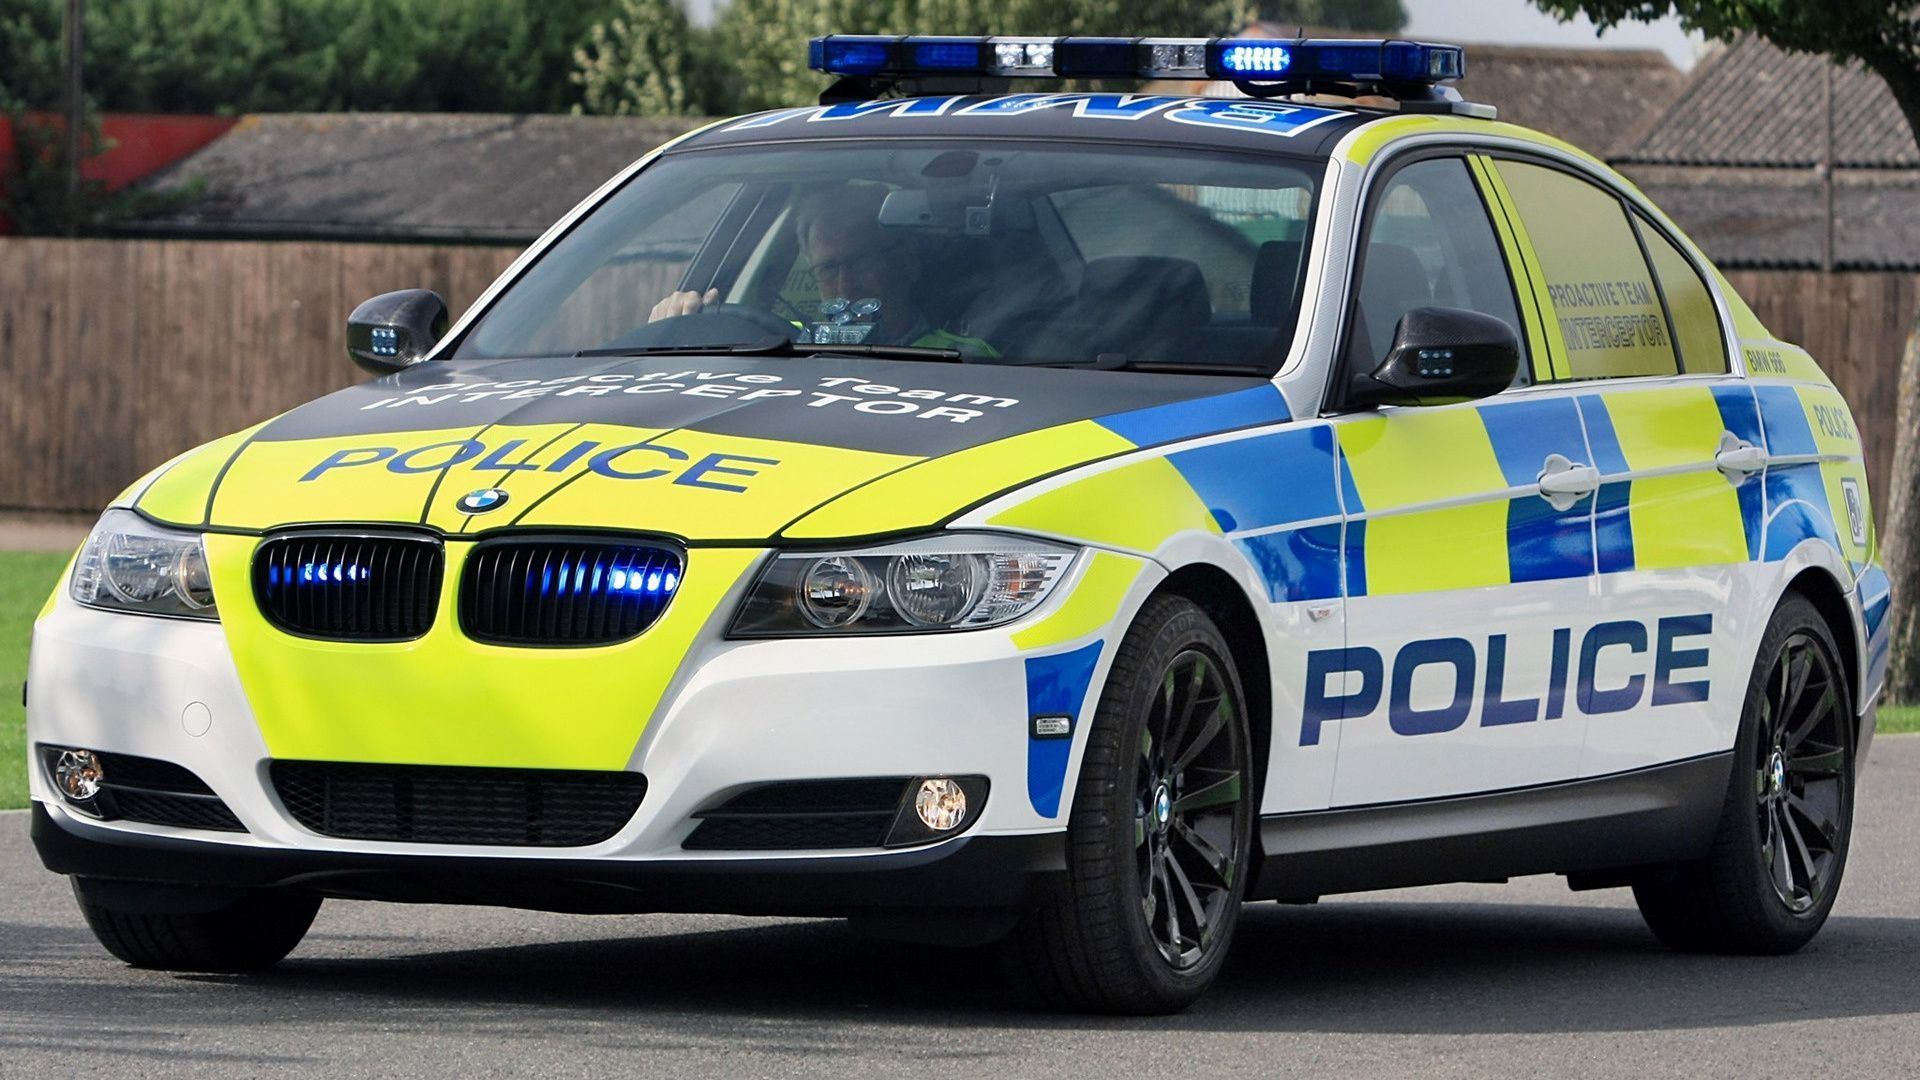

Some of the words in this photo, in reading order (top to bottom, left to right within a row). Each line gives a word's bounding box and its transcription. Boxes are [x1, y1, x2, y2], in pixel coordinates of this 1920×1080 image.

[1548, 281, 1619, 308] PROACTIVE
[1617, 280, 1652, 305] TEAM
[1559, 314, 1667, 351] INTERCEPTOR
[1746, 349, 1773, 373] BMW
[360, 382, 984, 424] INTERCEPTOR
[818, 376, 1020, 408] Team
[1813, 404, 1852, 440] POLICE
[299, 437, 780, 494] POLICE
[1298, 613, 1713, 747] POLICE
